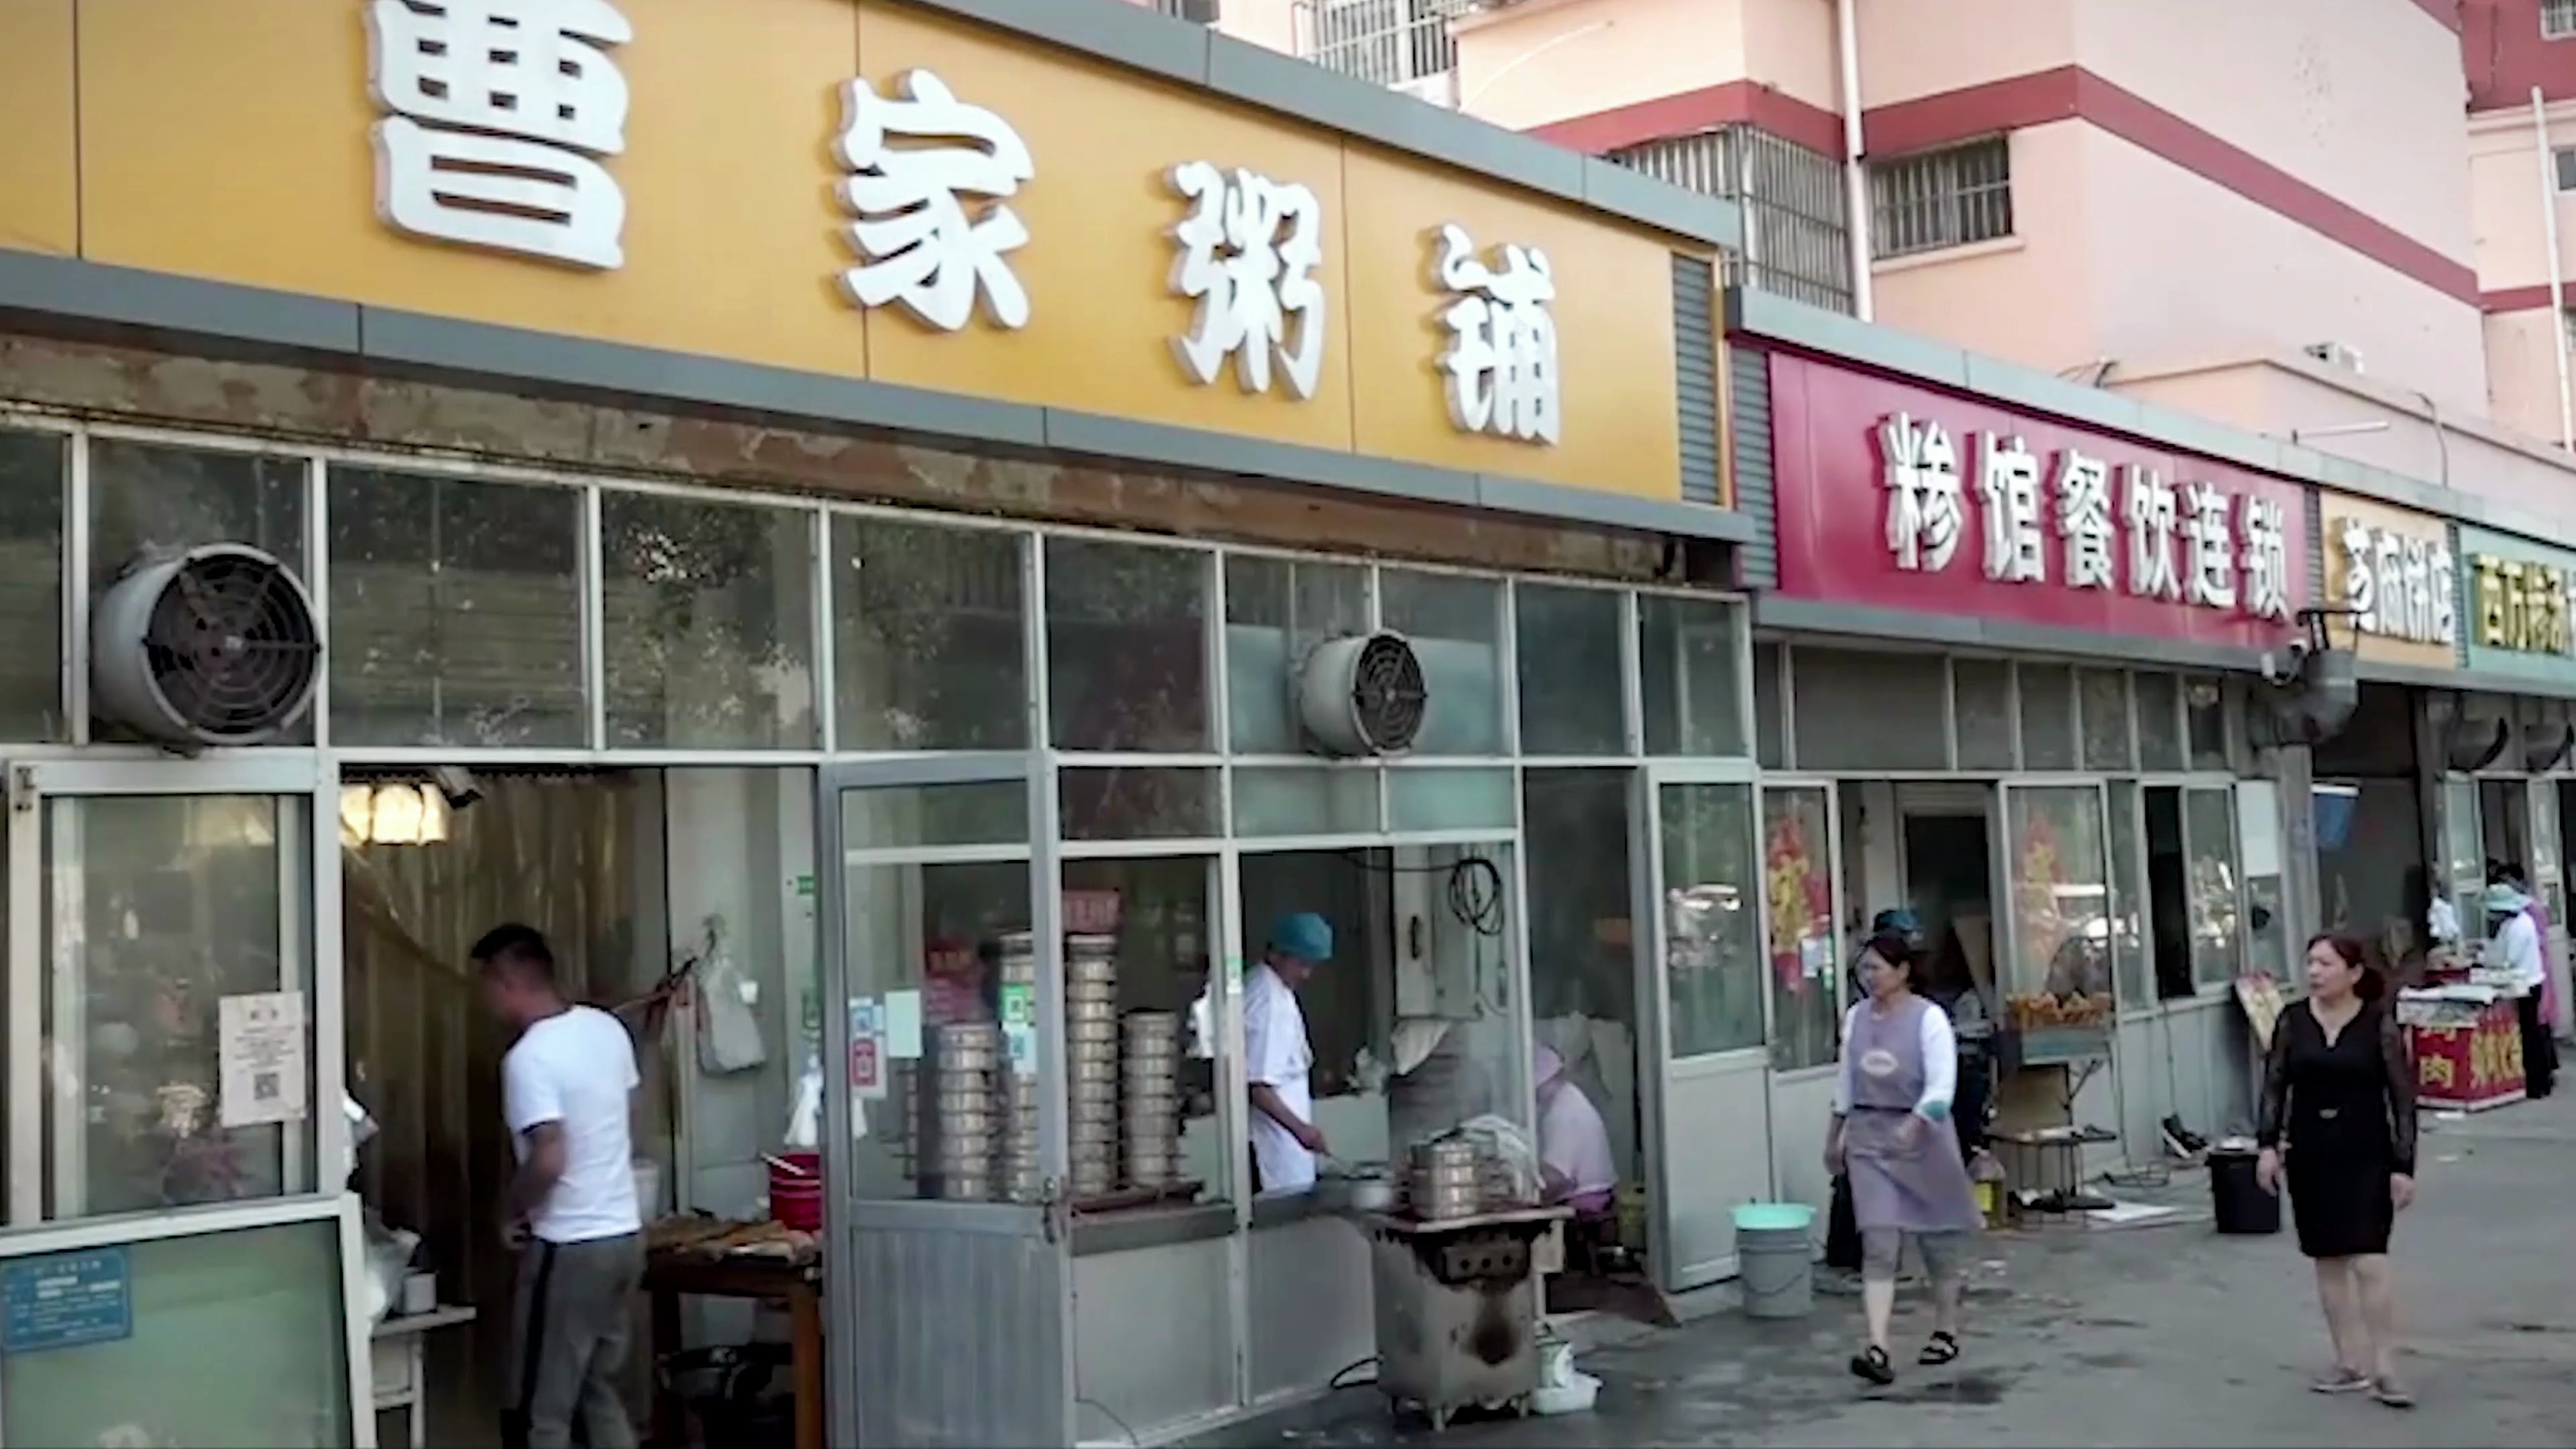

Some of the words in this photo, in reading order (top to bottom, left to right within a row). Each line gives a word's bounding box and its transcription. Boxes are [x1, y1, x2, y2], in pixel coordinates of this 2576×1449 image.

[369, 0, 1560, 446] 曹家粥铺
[1880, 411, 2289, 619] 糁馆餐饮连锁
